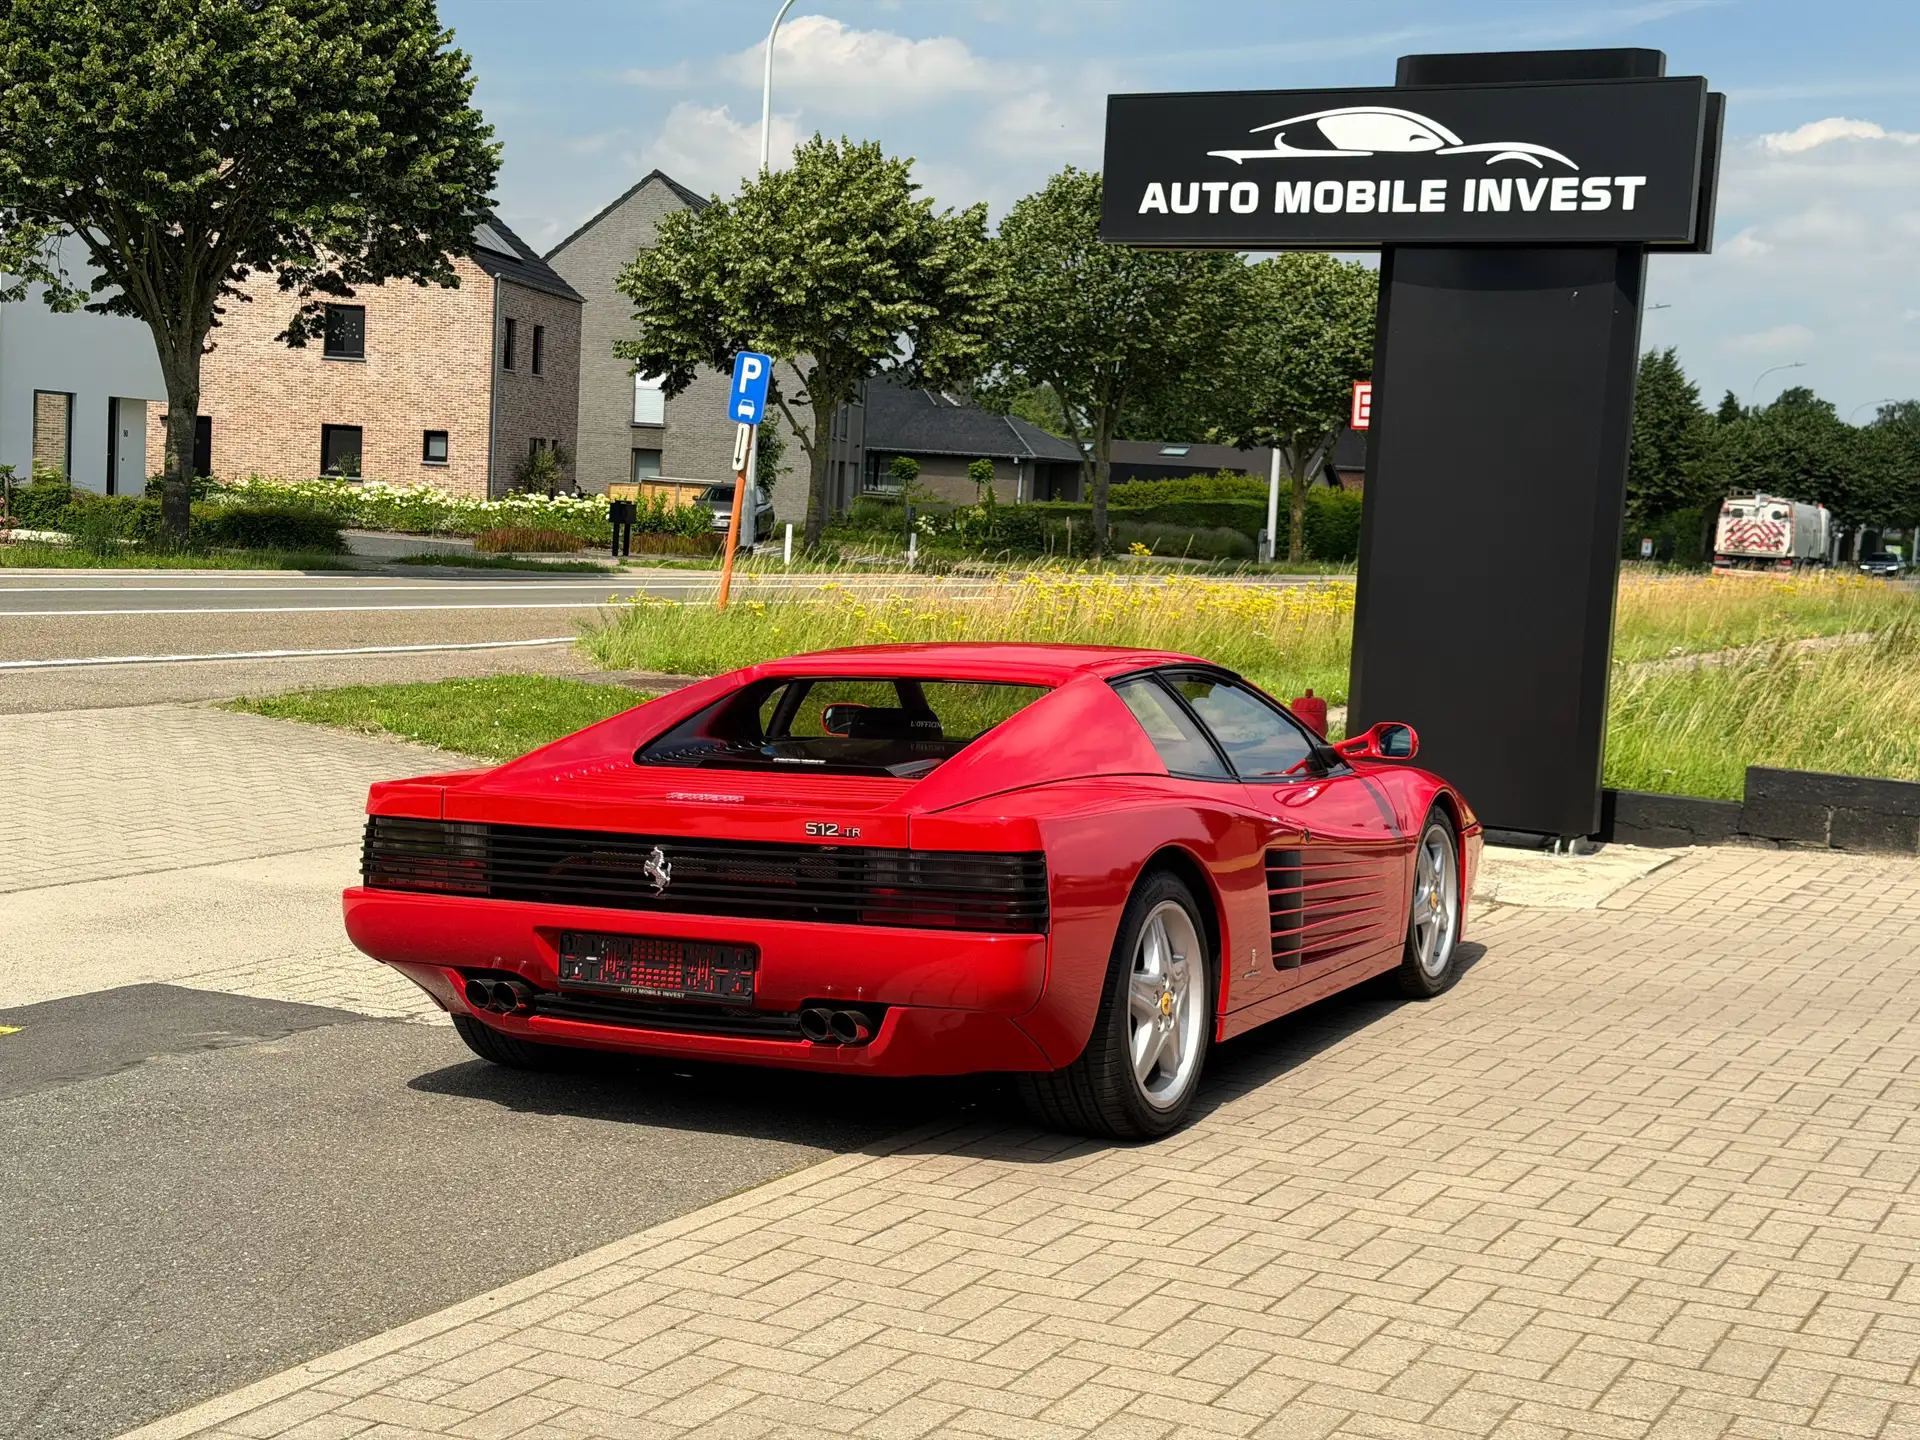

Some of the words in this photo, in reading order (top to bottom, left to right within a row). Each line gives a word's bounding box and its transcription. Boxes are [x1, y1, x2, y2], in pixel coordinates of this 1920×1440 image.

[1138, 181, 1260, 214] AUTO
[1274, 179, 1448, 214] MOBILE
[1462, 175, 1647, 213] INVEST
[739, 357, 762, 393] P
[805, 822, 839, 836] 512
[843, 827, 861, 837] TR
[620, 986, 638, 994] AUTO
[638, 988, 661, 996] MOBILE
